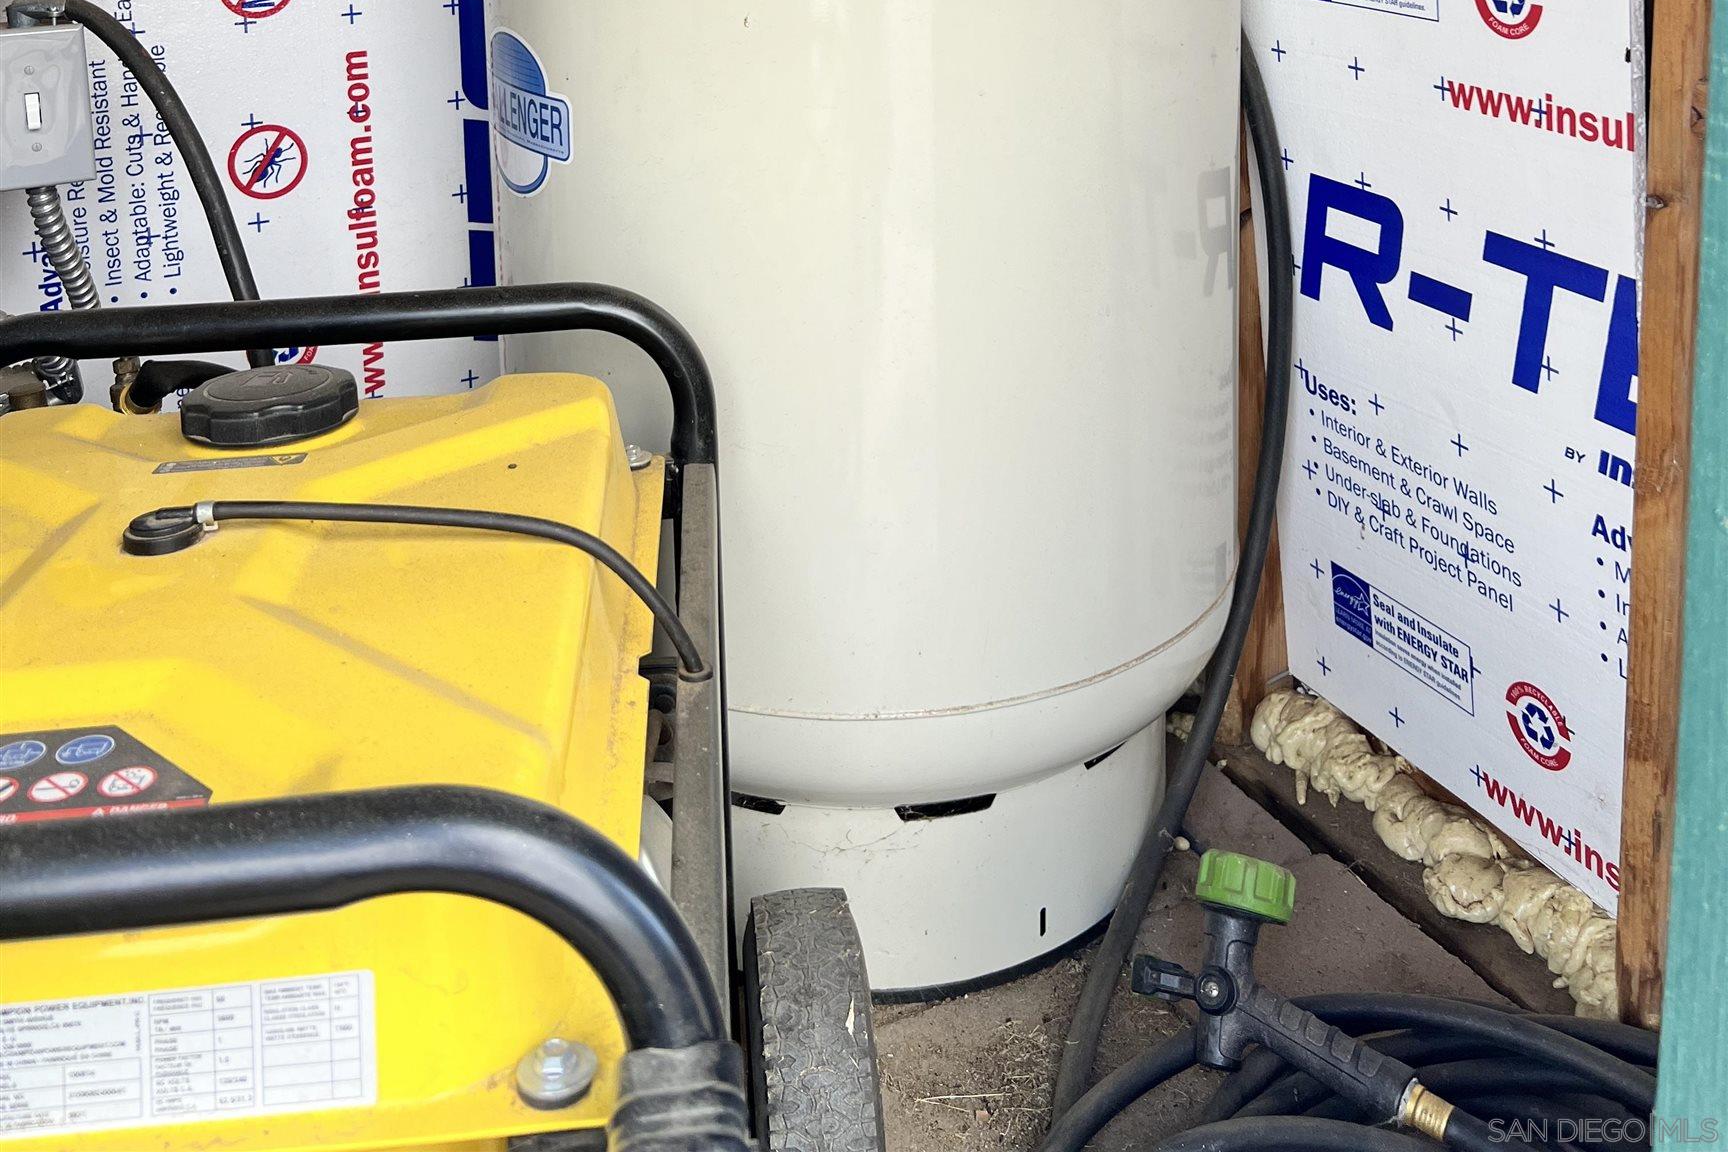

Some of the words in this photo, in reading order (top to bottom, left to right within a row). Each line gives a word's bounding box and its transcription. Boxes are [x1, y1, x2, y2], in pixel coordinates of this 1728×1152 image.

[1488, 16, 1509, 34] FOAM
[1510, 23, 1530, 35] CORE
[89, 59, 112, 150] Resistant
[122, 113, 140, 129] &
[96, 157, 116, 204] Mold
[126, 136, 144, 177] Cuts
[155, 151, 174, 166] &
[100, 208, 118, 223] &
[130, 183, 153, 282] Adaptable:
[158, 167, 185, 279] Lightweight
[105, 227, 123, 287] Insect
[1304, 369, 1357, 416] Uses:
[1321, 410, 1371, 449] Interior
[1375, 438, 1387, 459] &
[1391, 446, 1449, 490] Exterior
[1453, 477, 1498, 516] Walls
[1564, 446, 1586, 463] BY
[1323, 436, 1397, 490] Basement
[1400, 478, 1412, 499] &
[1416, 486, 1458, 524] Crawl
[1462, 512, 1515, 555] Space
[1325, 464, 1401, 519] Under-slab
[1405, 508, 1417, 529] &
[1421, 516, 1522, 588] Foundations
[1327, 490, 1350, 516] DIY
[1354, 507, 1366, 525] &
[1369, 514, 1406, 550] Craft
[1409, 537, 1464, 584] Project
[1467, 571, 1514, 612] Panel
[1372, 593, 1395, 617] Seal
[1397, 610, 1416, 631] and
[1417, 622, 1460, 659] Insulate
[1374, 615, 1396, 636] with
[1397, 628, 1438, 662] ENERGY
[1440, 655, 1469, 684] STAR
[1521, 738, 1539, 760] FOAM
